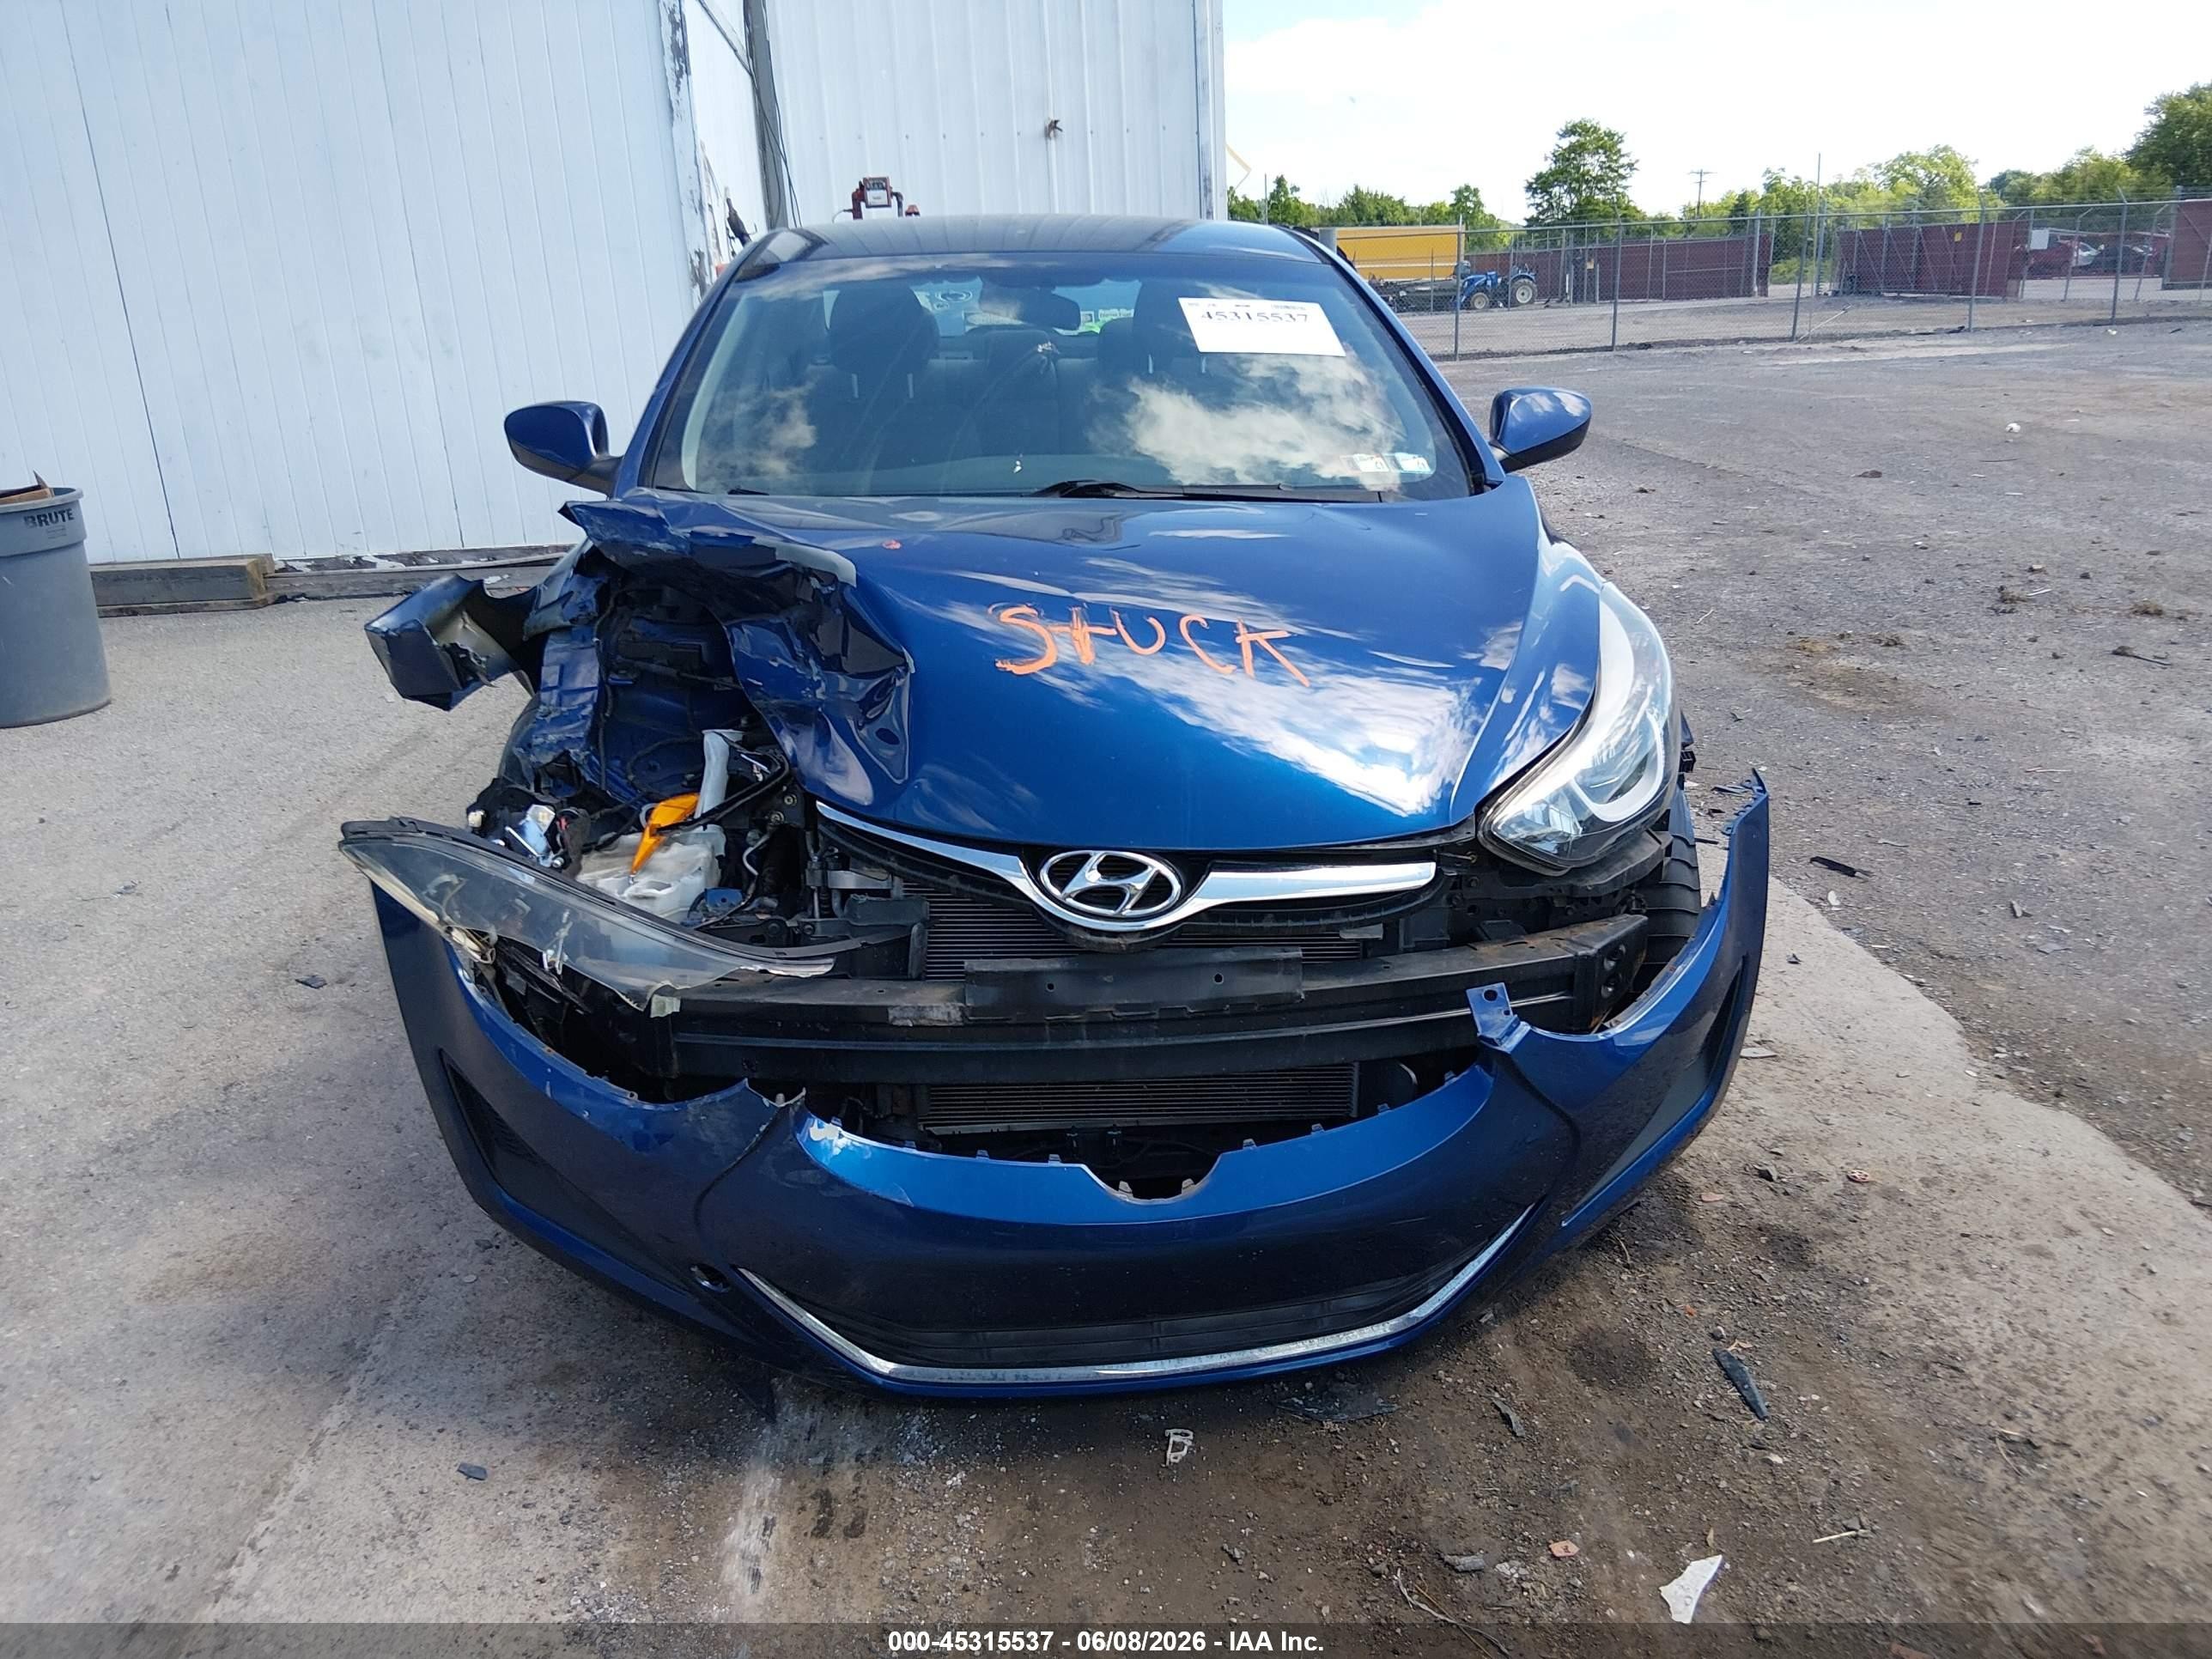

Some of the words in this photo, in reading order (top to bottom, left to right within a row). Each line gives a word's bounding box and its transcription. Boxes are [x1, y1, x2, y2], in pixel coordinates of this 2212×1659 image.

[1200, 310, 1309, 324] 45315537
[23, 507, 75, 529] BRUTE
[990, 604, 1310, 688] STUCK
